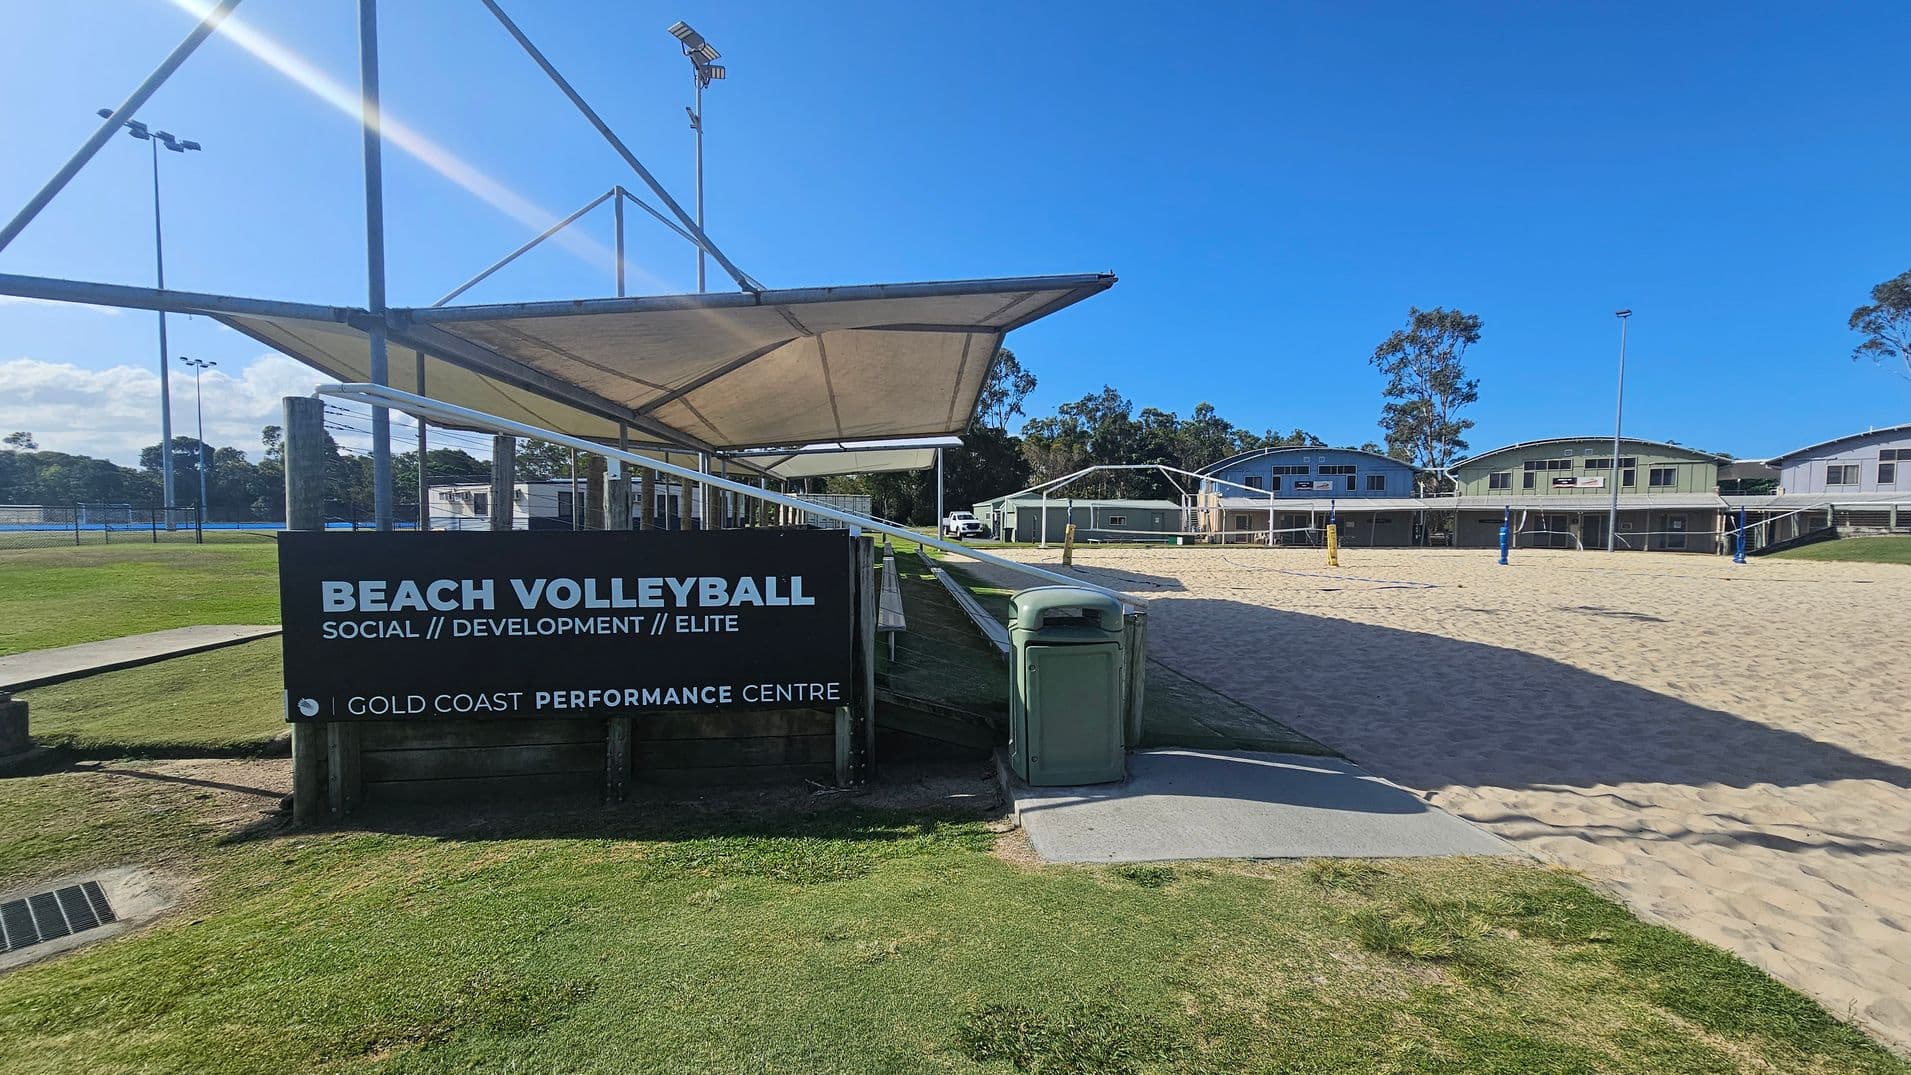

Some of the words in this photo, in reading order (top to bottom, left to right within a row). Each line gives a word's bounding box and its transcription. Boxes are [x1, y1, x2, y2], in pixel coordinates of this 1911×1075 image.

[322, 580, 495, 613] BEACH
[510, 576, 815, 610] VOLLEYBALL
[322, 620, 420, 640] SOCIAL
[453, 616, 645, 637] DEVELOPMENT
[676, 614, 740, 633] ELITE
[347, 695, 426, 715] GOLD
[434, 692, 523, 713] COAST
[536, 686, 732, 710] PERFORMANCE
[742, 682, 841, 703] CENTRE
